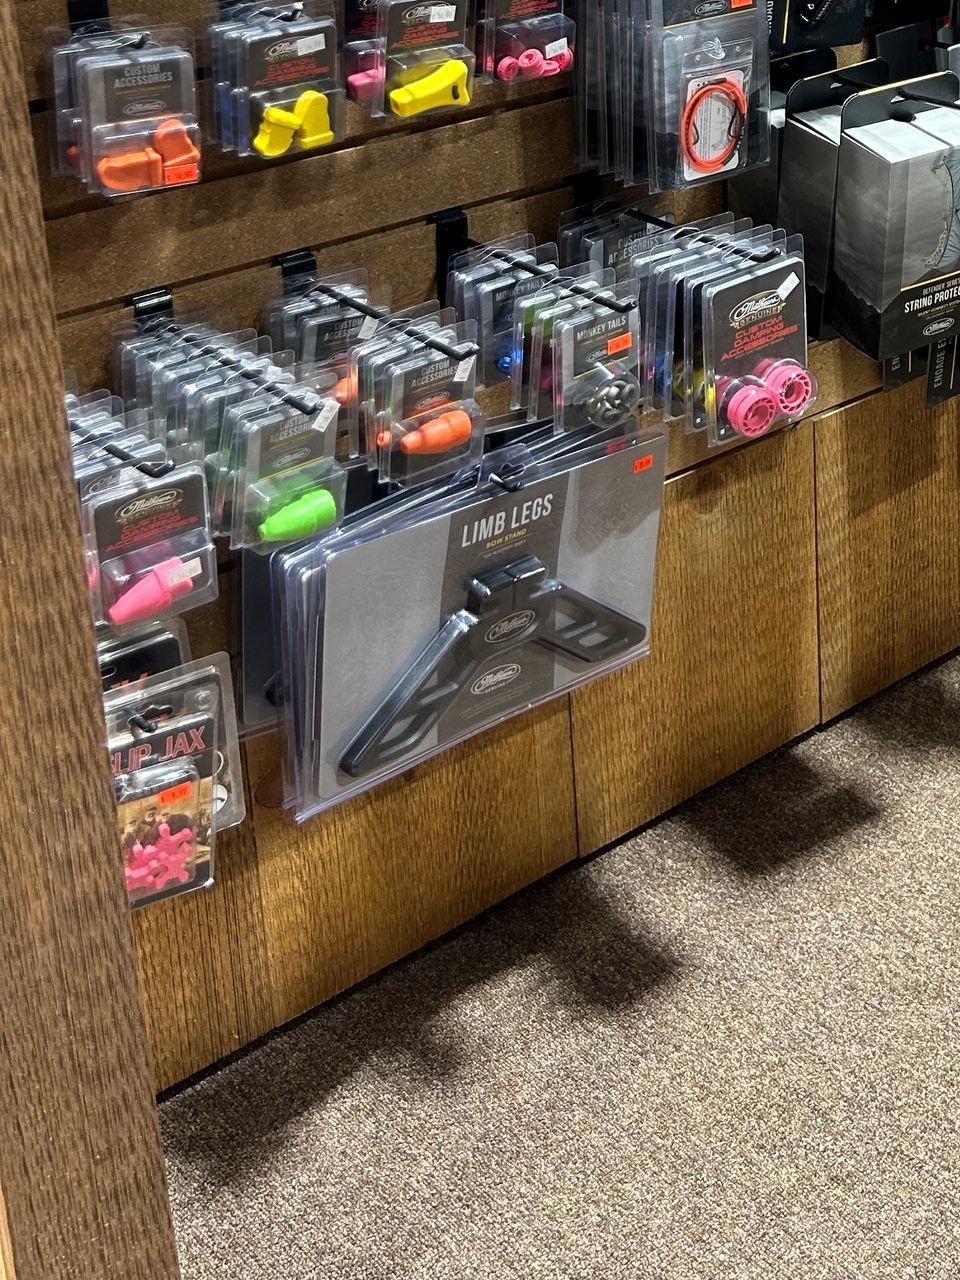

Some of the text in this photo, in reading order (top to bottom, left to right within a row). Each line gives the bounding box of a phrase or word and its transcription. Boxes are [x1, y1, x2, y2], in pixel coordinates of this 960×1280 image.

[113, 71, 174, 88] ACCESSORIES
[124, 63, 160, 77] CUSTOM
[734, 292, 781, 322] Mathews
[904, 295, 933, 314] STRING
[577, 316, 627, 342] MONKEY TAILS
[734, 322, 784, 348] DAMPING
[735, 315, 783, 339] CUSTOM
[720, 323, 799, 361] ACCESSORIES
[420, 359, 450, 376] CUSTOM
[934, 346, 946, 389] ENGAGE
[279, 414, 310, 431] CUSTOM
[121, 490, 177, 517] Mathews
[461, 493, 554, 548] LIMB LEGS
[486, 536, 504, 549] BOW
[504, 528, 527, 542] STAND
[475, 665, 518, 692] Mathews
[160, 725, 206, 761] JAX
